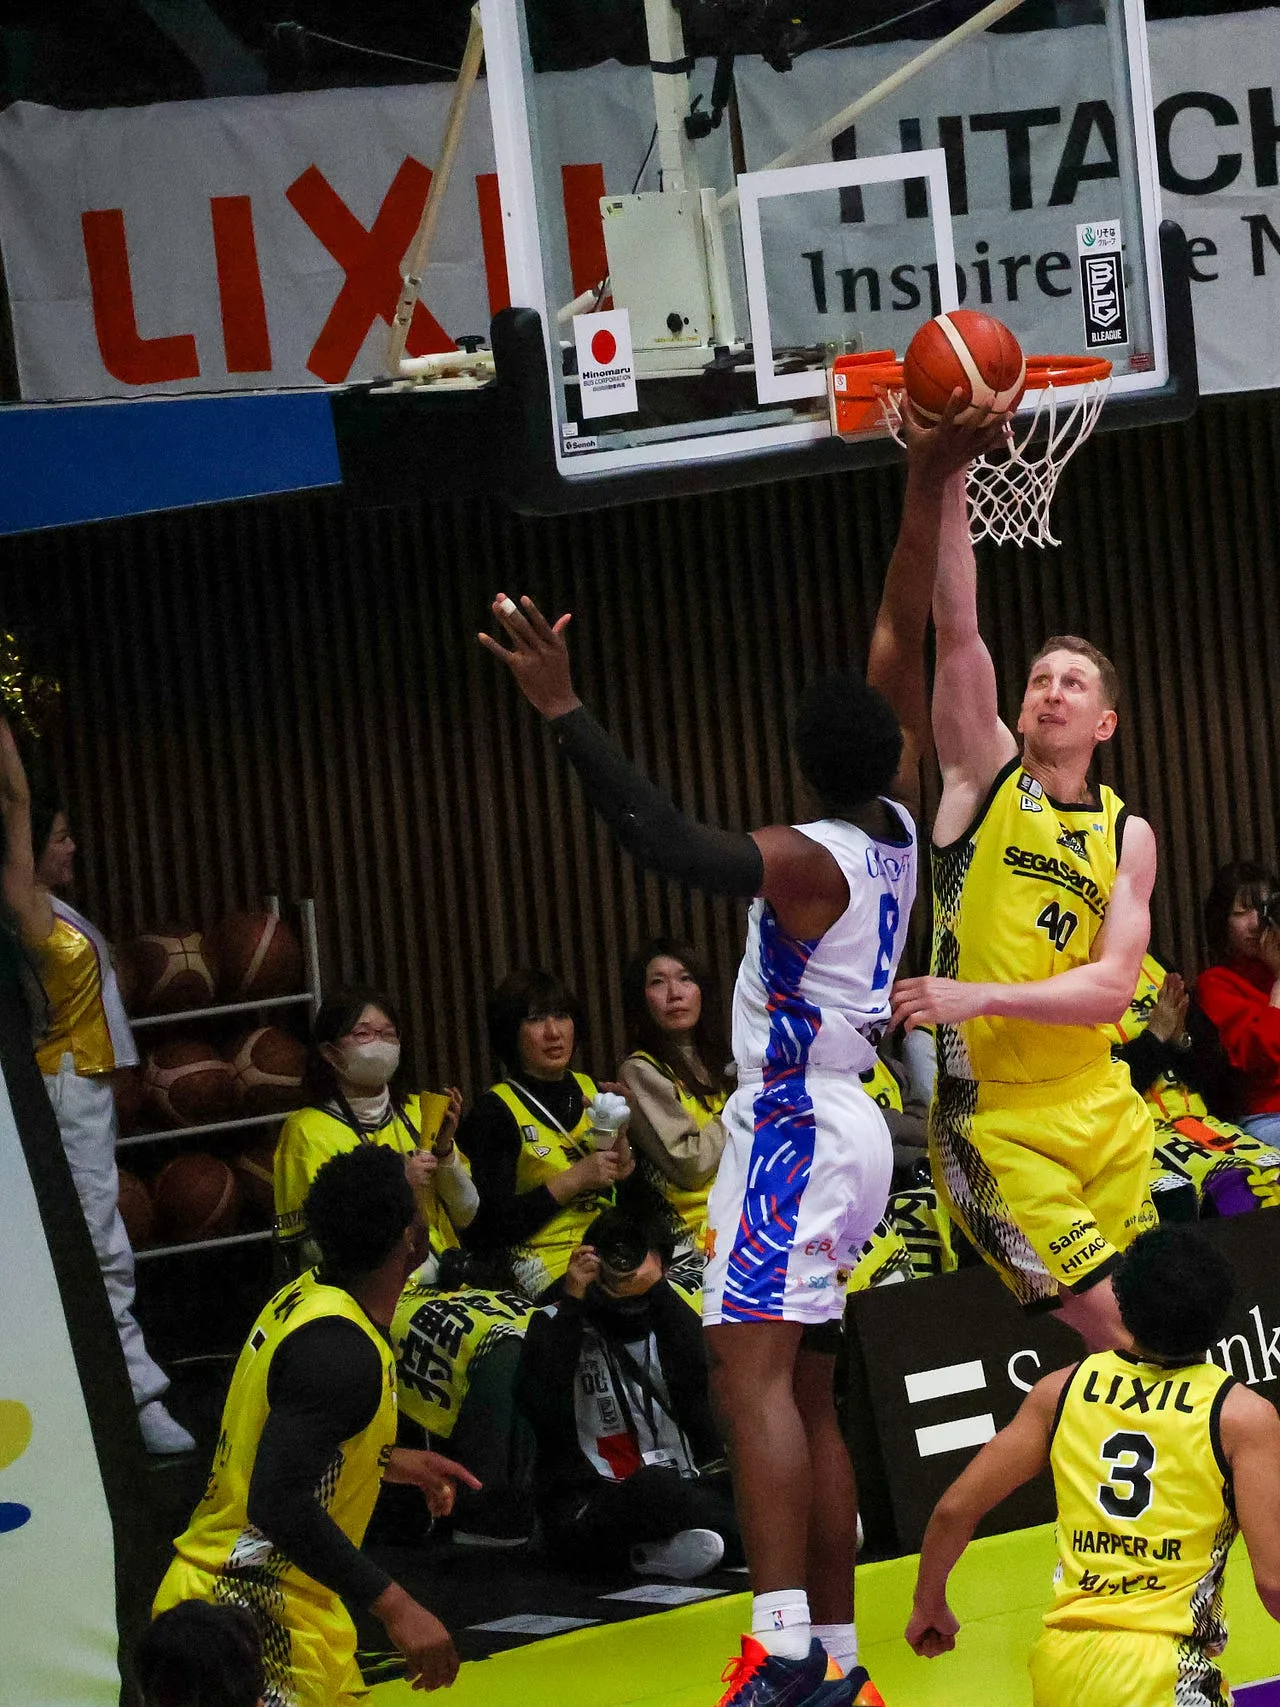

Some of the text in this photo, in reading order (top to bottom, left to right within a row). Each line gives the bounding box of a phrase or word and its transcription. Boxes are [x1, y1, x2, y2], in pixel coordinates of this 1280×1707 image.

[801, 240, 1072, 319] Inspire
[582, 367, 631, 380] Hinomaru
[872, 893, 899, 990] 8
[1037, 901, 1079, 952] 40
[1060, 1234, 1108, 1273] HITAC
[1083, 1370, 1194, 1414] LIXIL
[1097, 1430, 1156, 1521] 3
[1072, 1529, 1182, 1561] HARPER JR
